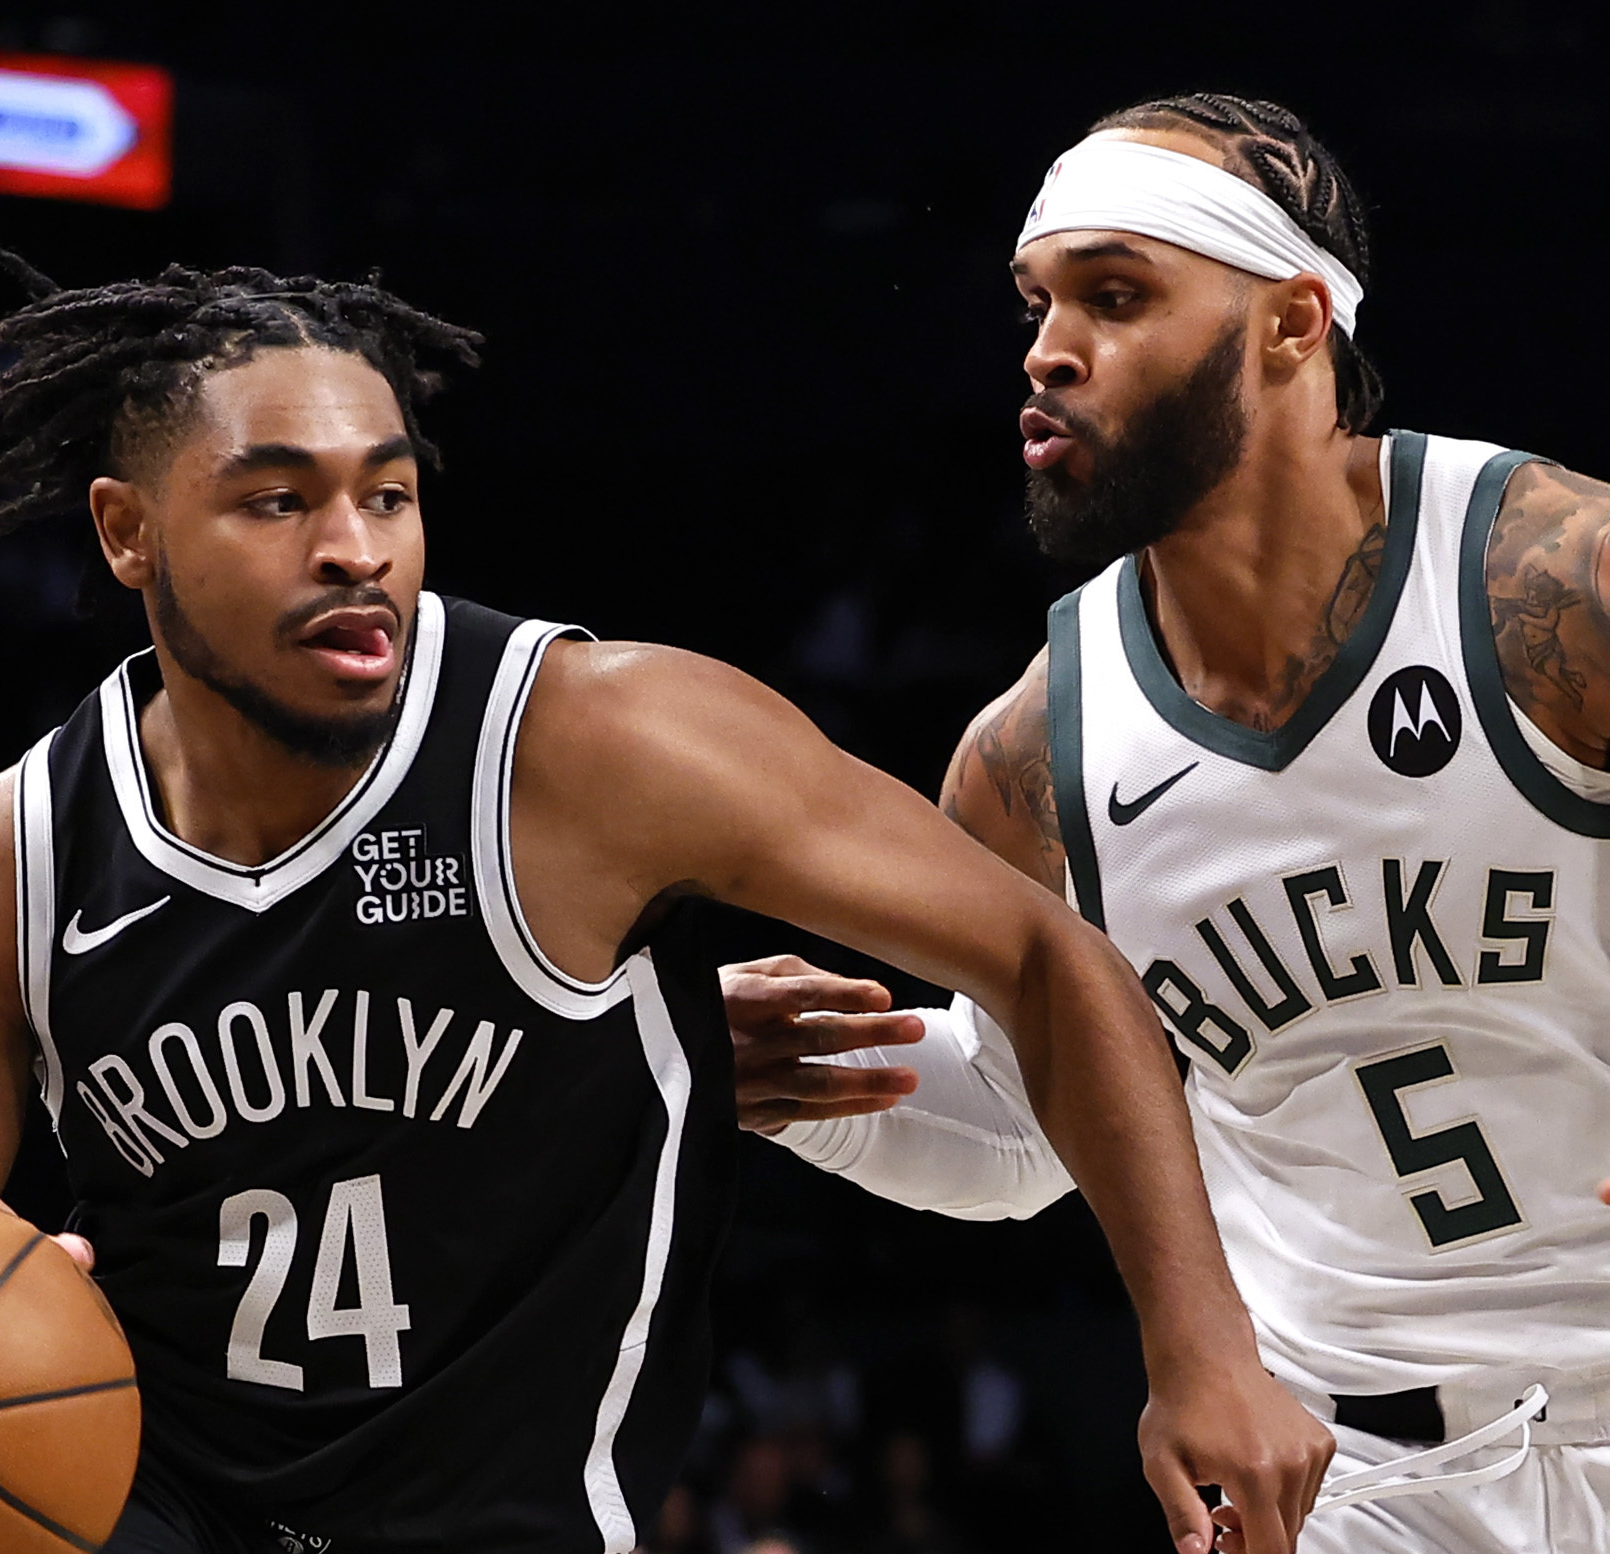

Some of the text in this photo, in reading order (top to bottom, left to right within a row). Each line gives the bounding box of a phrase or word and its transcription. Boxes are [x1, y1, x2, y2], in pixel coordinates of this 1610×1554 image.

[352, 829, 422, 861] GET
[353, 857, 460, 892] YOUR
[356, 887, 467, 924] GUIDE
[1140, 857, 1557, 1079] BUCKS
[76, 988, 523, 1177] BROOKLYN
[1352, 1037, 1531, 1254] 5
[217, 1173, 410, 1391] 24
